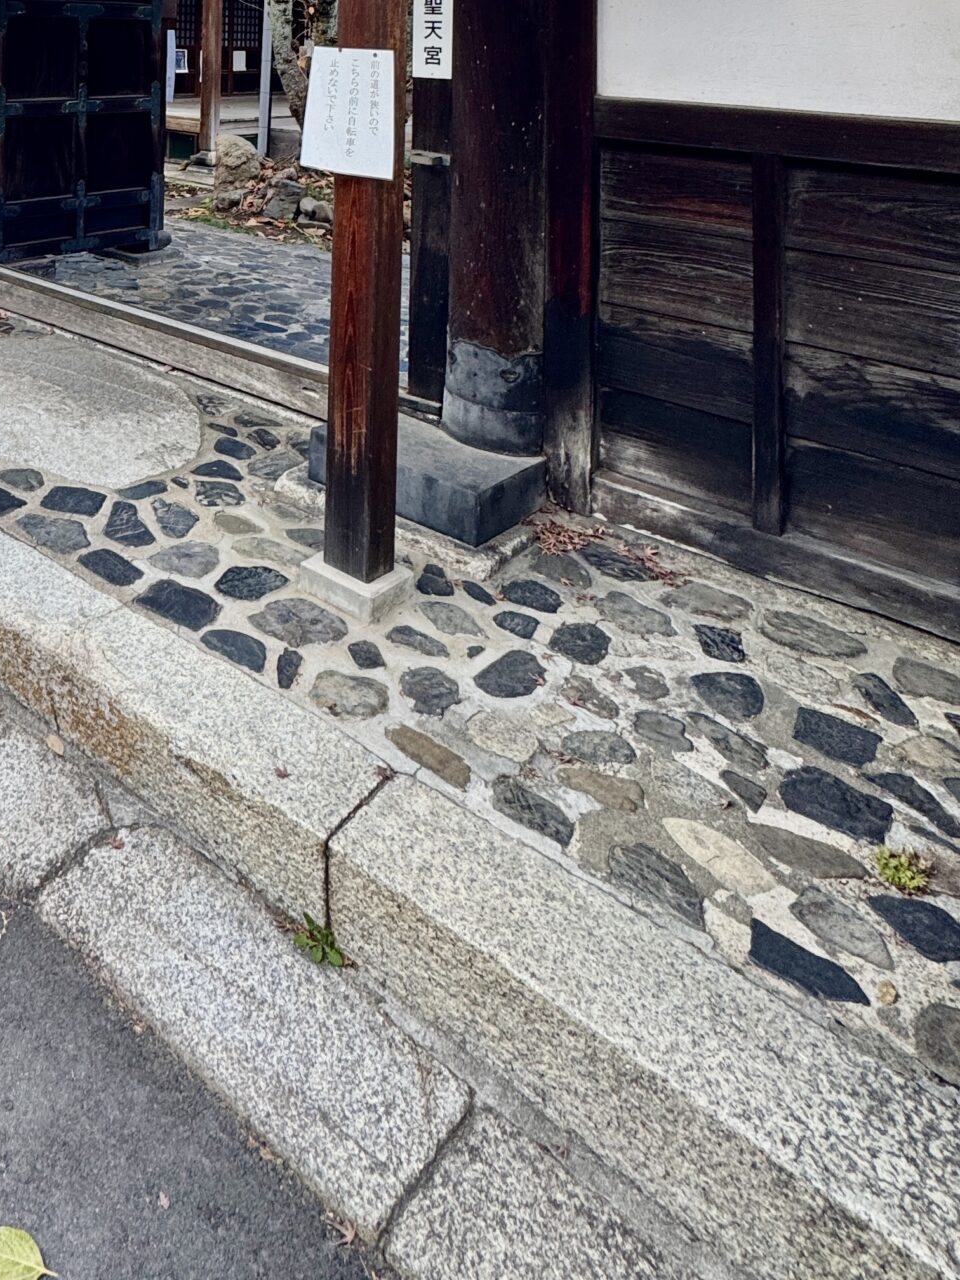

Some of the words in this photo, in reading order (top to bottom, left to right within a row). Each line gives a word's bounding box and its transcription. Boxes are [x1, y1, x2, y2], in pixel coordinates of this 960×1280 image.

[324, 59, 339, 131] 止めないで下さい
[345, 59, 360, 157] こちらの前に自転車を
[369, 60, 380, 136] 前の道が狭いので
